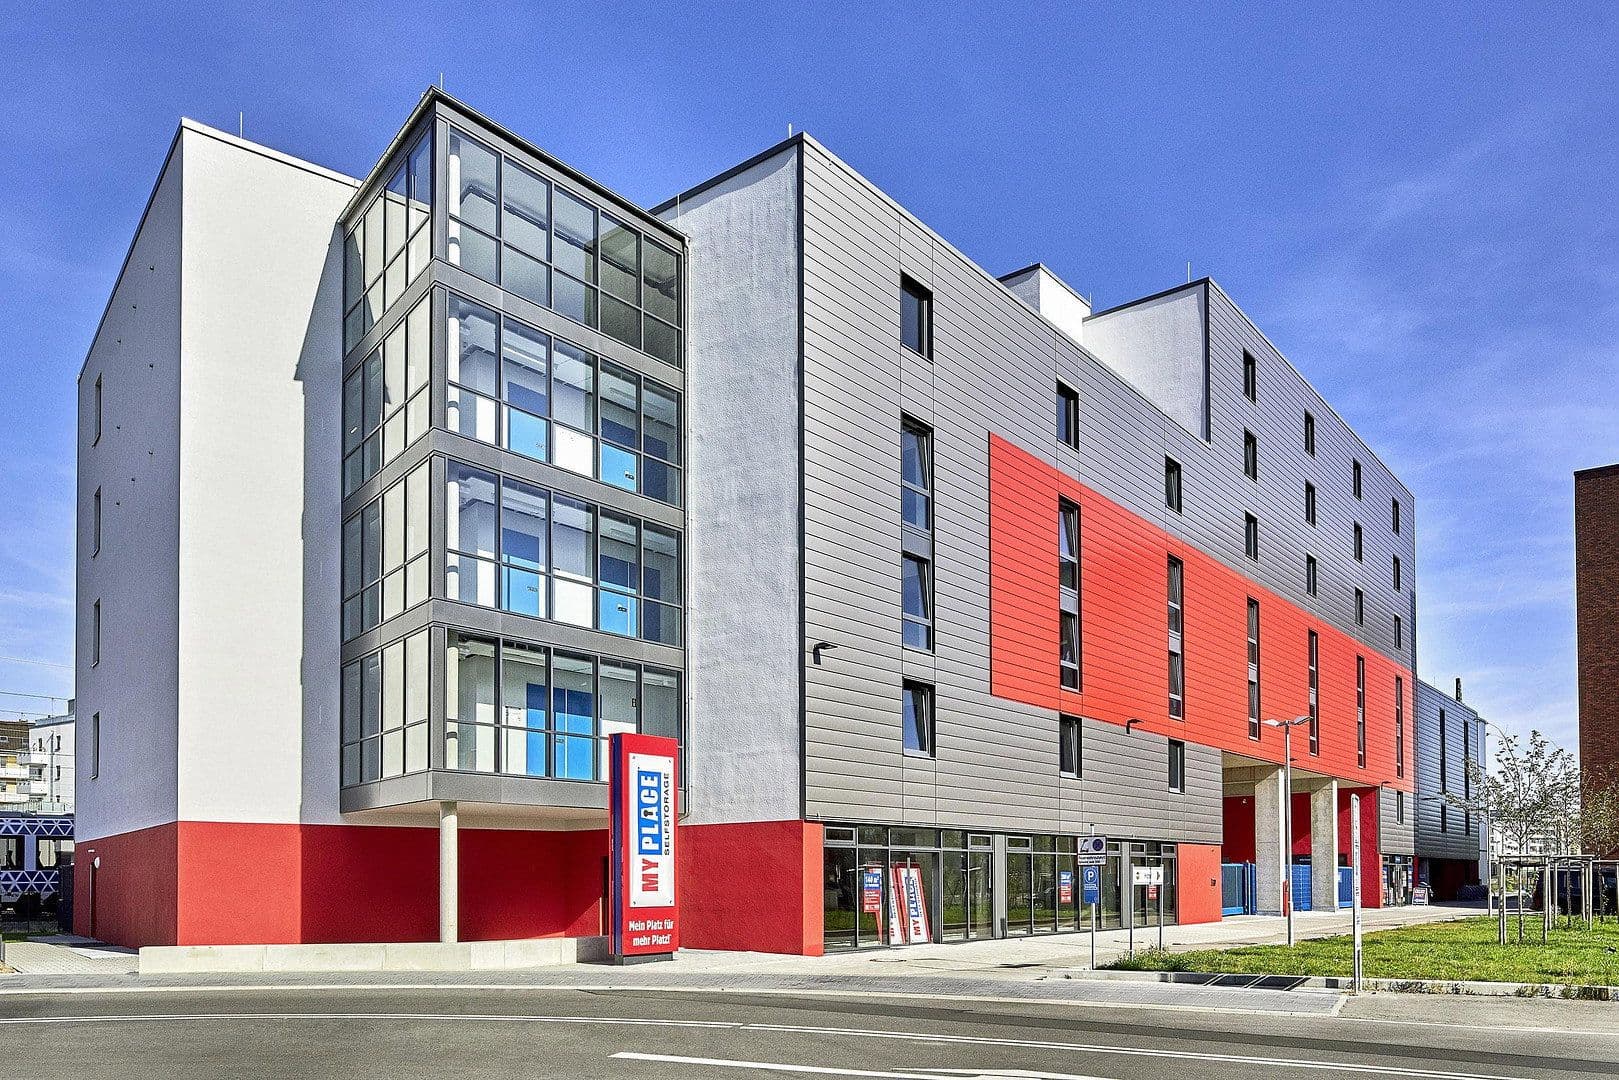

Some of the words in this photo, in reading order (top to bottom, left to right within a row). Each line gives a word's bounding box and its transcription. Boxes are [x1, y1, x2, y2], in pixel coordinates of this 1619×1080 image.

[640, 775, 660, 850] PLACE
[641, 858, 659, 892] MY
[628, 920, 646, 932] Mein
[646, 919, 663, 931] Platz
[663, 918, 674, 930] für
[632, 935, 651, 947] mehr
